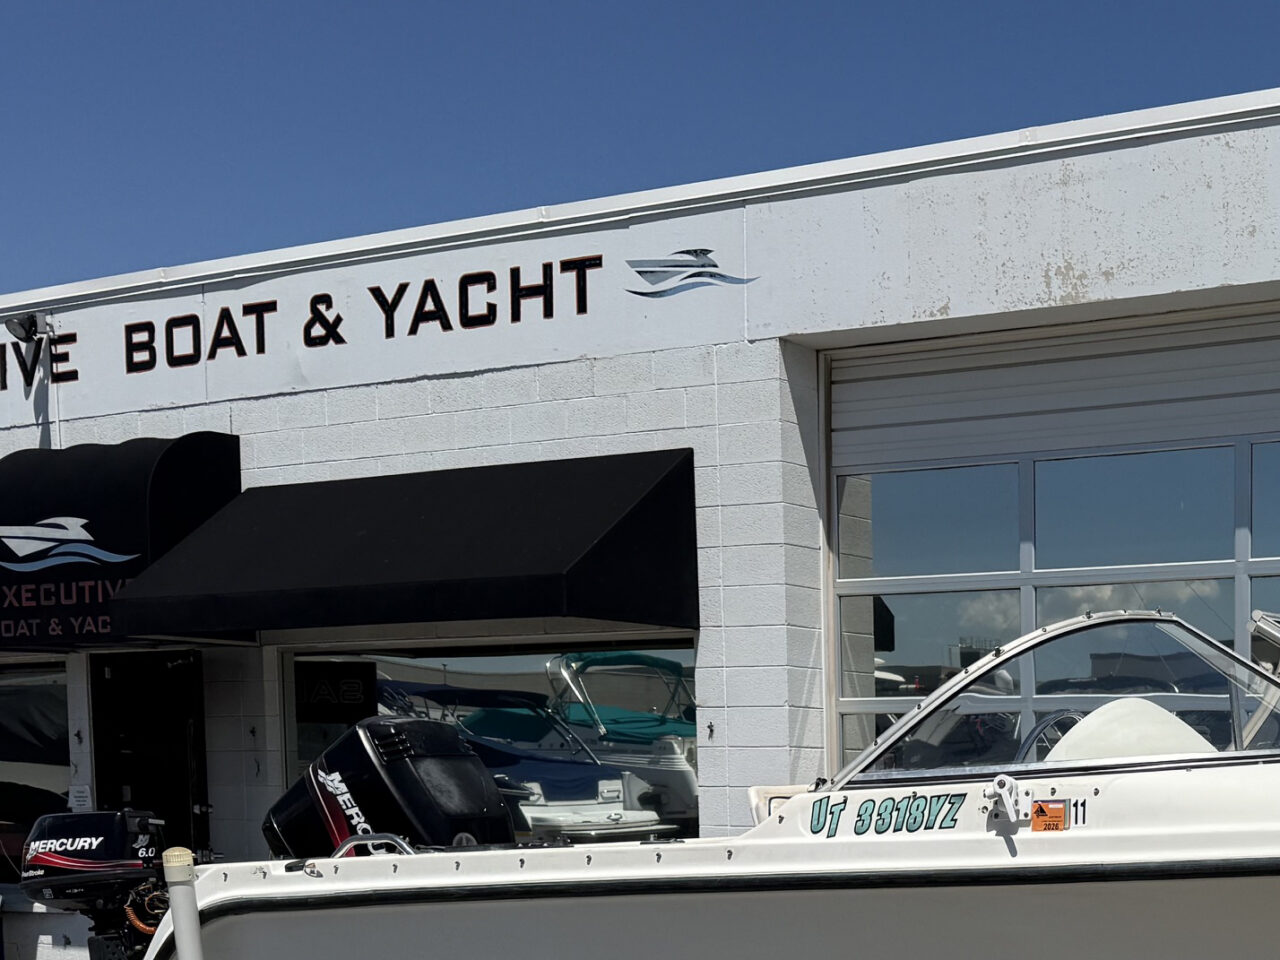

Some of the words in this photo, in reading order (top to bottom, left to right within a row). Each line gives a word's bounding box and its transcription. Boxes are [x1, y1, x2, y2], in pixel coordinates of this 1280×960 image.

[0, 332, 79, 391] IVE
[124, 299, 278, 374] BOAT
[303, 292, 348, 348] &
[367, 254, 604, 339] YACHT
[2, 579, 133, 608] XECUTIV
[1, 619, 41, 637] OAT
[48, 617, 63, 636] &
[810, 795, 850, 838] UT
[853, 792, 968, 836] 3318YZ
[1072, 798, 1087, 825] 11
[1043, 822, 1060, 831] 2026
[28, 836, 104, 855] MERCURY
[138, 847, 156, 857] 6.0
